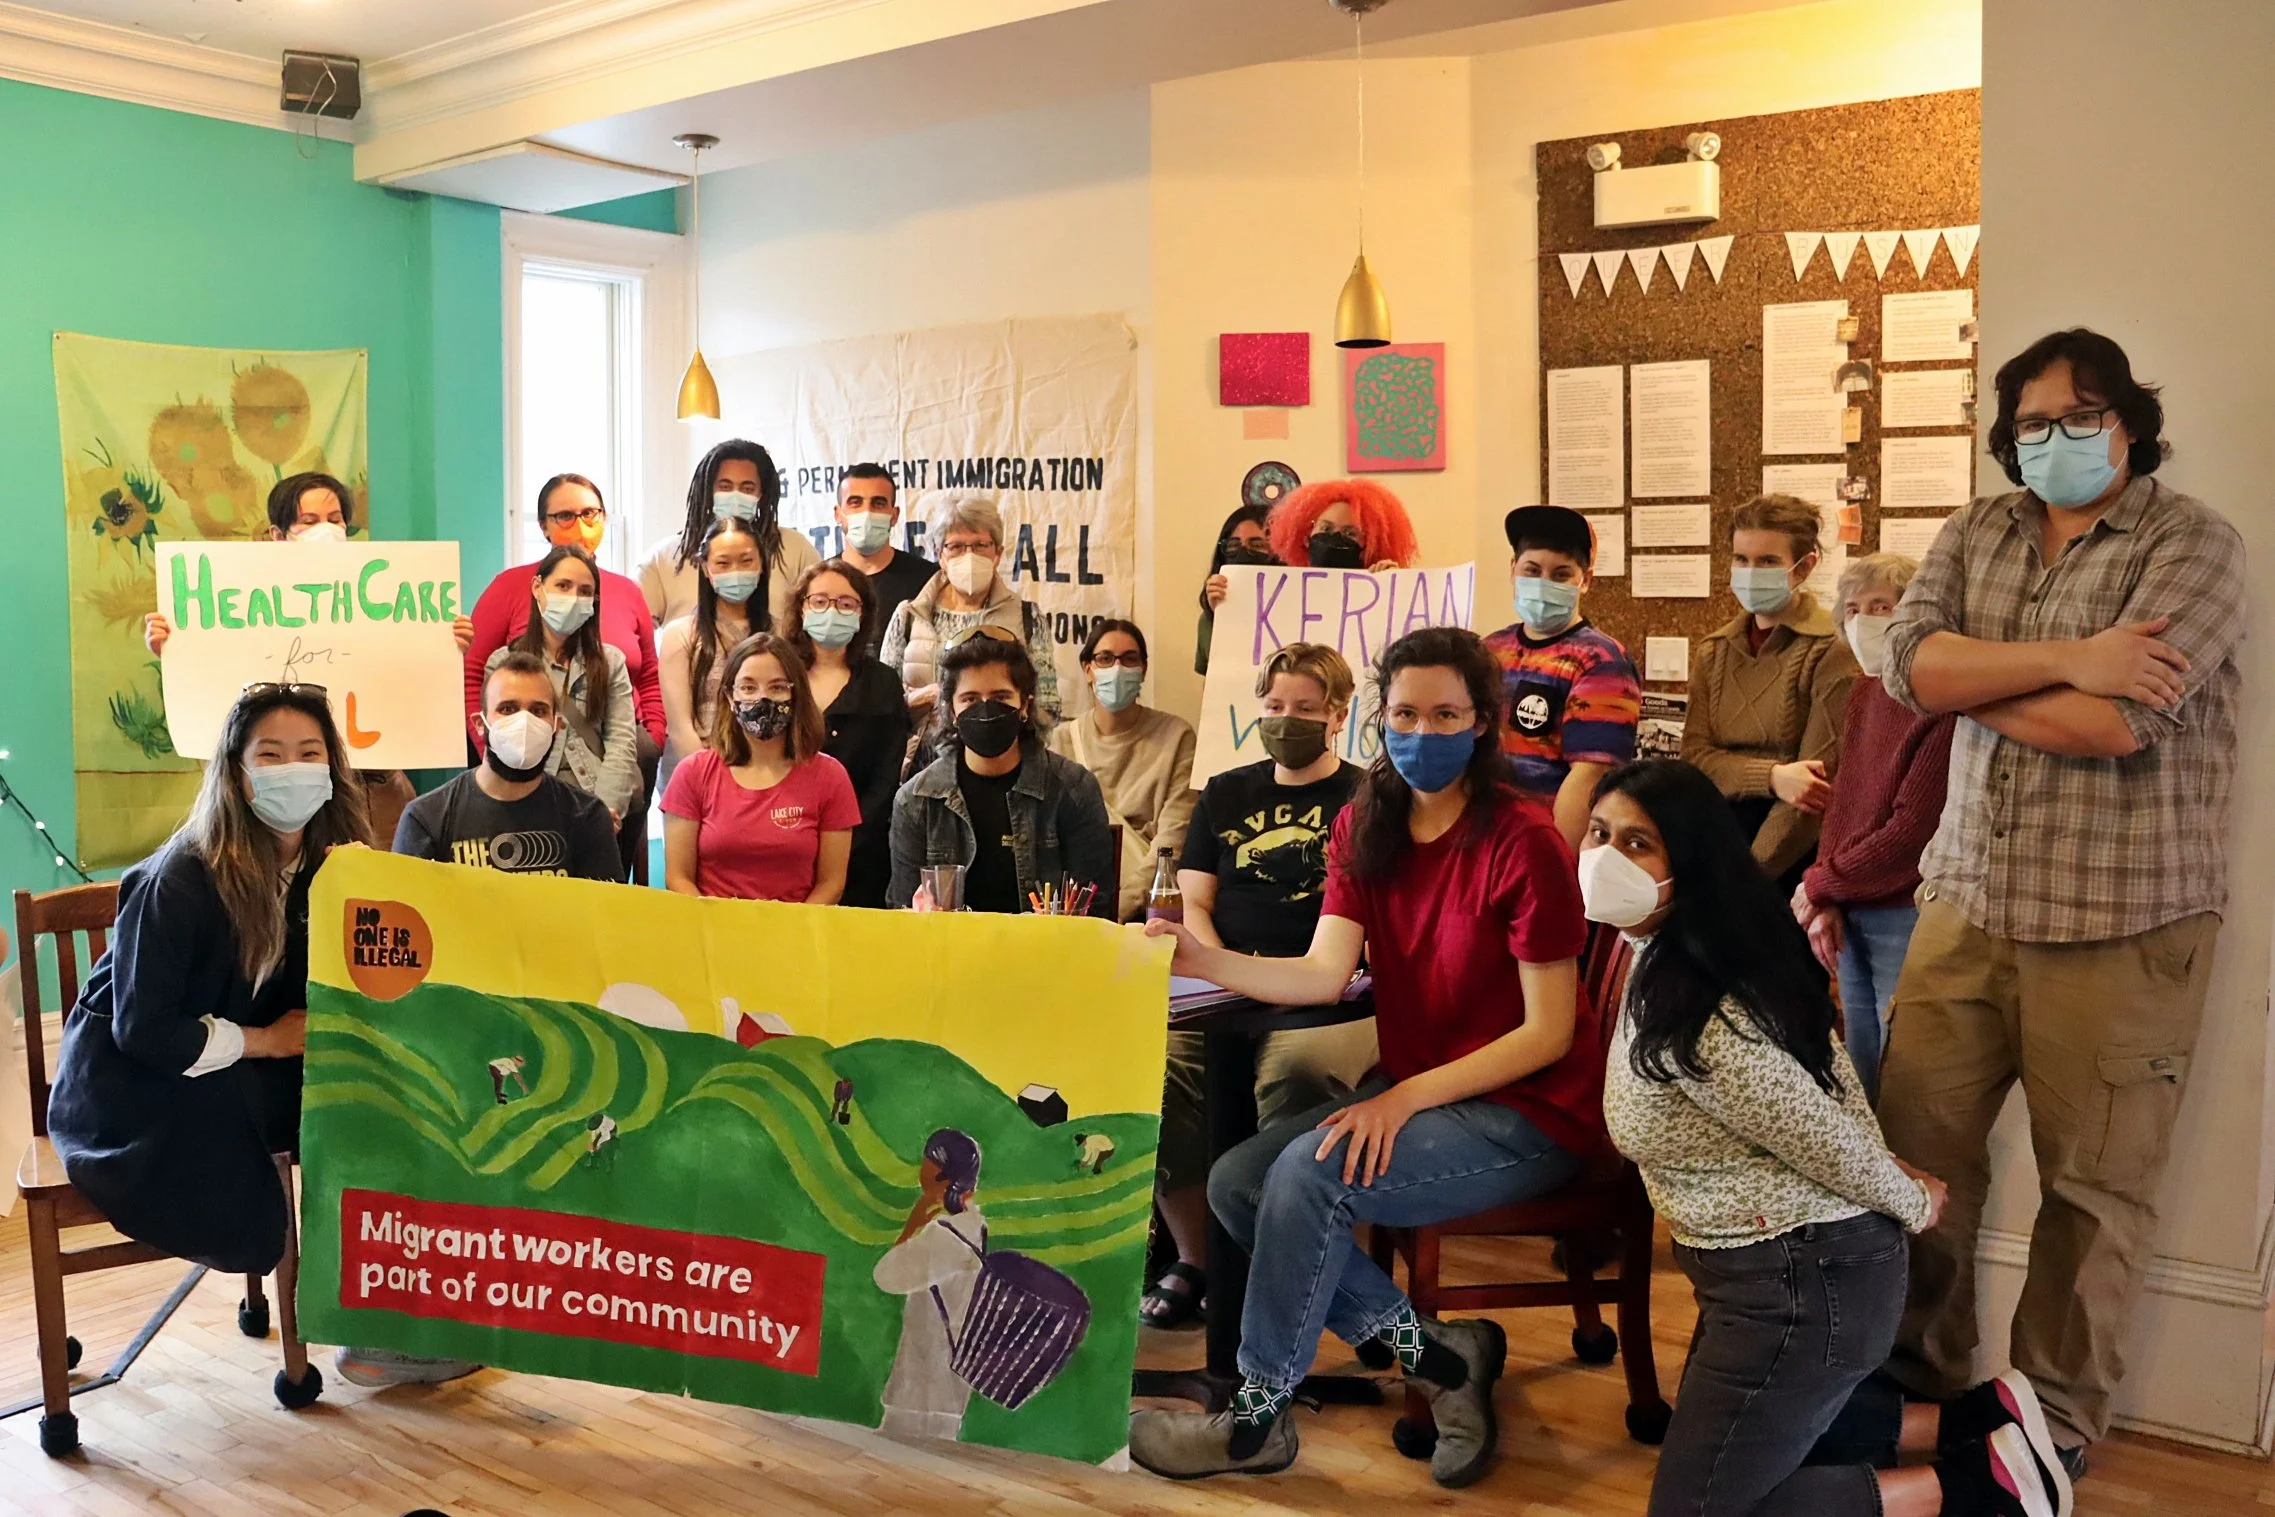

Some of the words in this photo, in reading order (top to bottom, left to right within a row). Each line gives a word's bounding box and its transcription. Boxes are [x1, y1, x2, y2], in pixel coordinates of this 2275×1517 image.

[1568, 243, 1723, 282] QUEER
[936, 457, 1104, 491] IMMIGRATION
[1012, 523, 1104, 586] ALL
[770, 807, 788, 820] LAKE
[788, 806, 804, 817] CITY
[451, 837, 490, 867] THE
[355, 906, 381, 927] NO
[353, 926, 389, 947] ONE
[392, 927, 411, 948] IS
[353, 946, 422, 968] ILLEGAL
[360, 1211, 506, 1260] Migrant
[512, 1233, 674, 1282] workers
[685, 1260, 752, 1294] are
[360, 1262, 432, 1298] part
[441, 1271, 477, 1302] of
[486, 1282, 552, 1311] our
[561, 1290, 800, 1359] community
